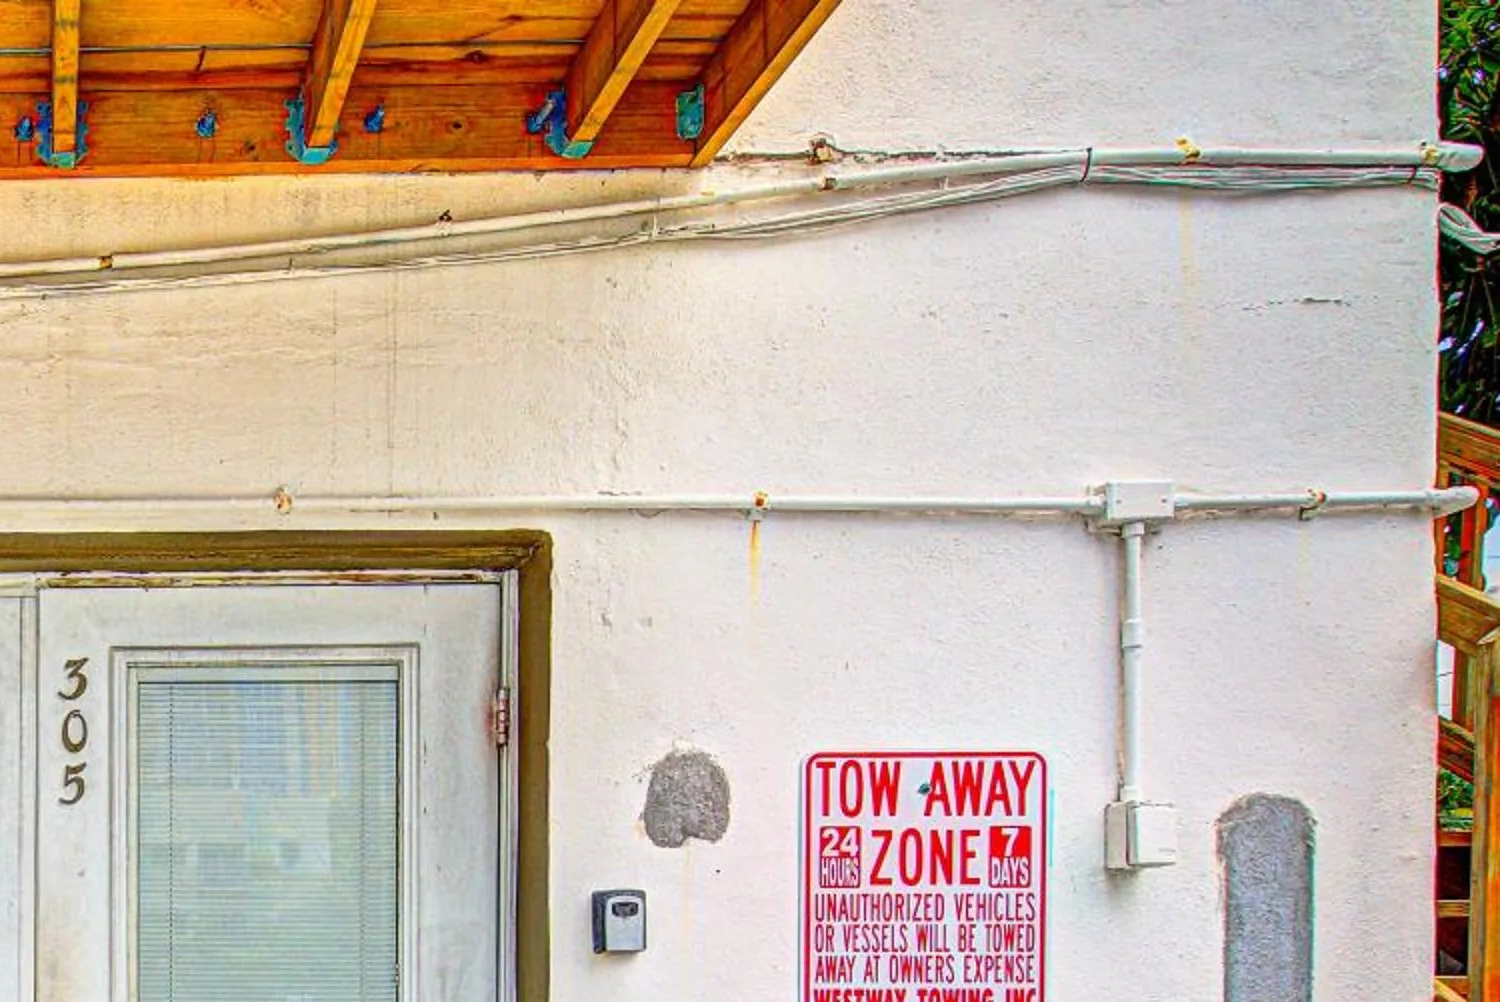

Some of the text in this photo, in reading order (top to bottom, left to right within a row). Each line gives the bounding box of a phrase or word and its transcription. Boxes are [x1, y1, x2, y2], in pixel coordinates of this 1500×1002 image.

[57, 657, 89, 805] 305
[816, 760, 1036, 818] TOW AWAY
[822, 828, 859, 857] 24
[1001, 828, 1019, 857] 7
[821, 857, 860, 886] HOURS
[870, 828, 981, 887] ZONE
[991, 857, 1030, 886] DAYS
[815, 893, 1036, 922] UNAUTHORIZED VEHICLES
[815, 924, 1035, 953] OR VESSELS WILL BE TOWED
[815, 955, 1034, 984] AWAY AT OWNERS EXPENSE
